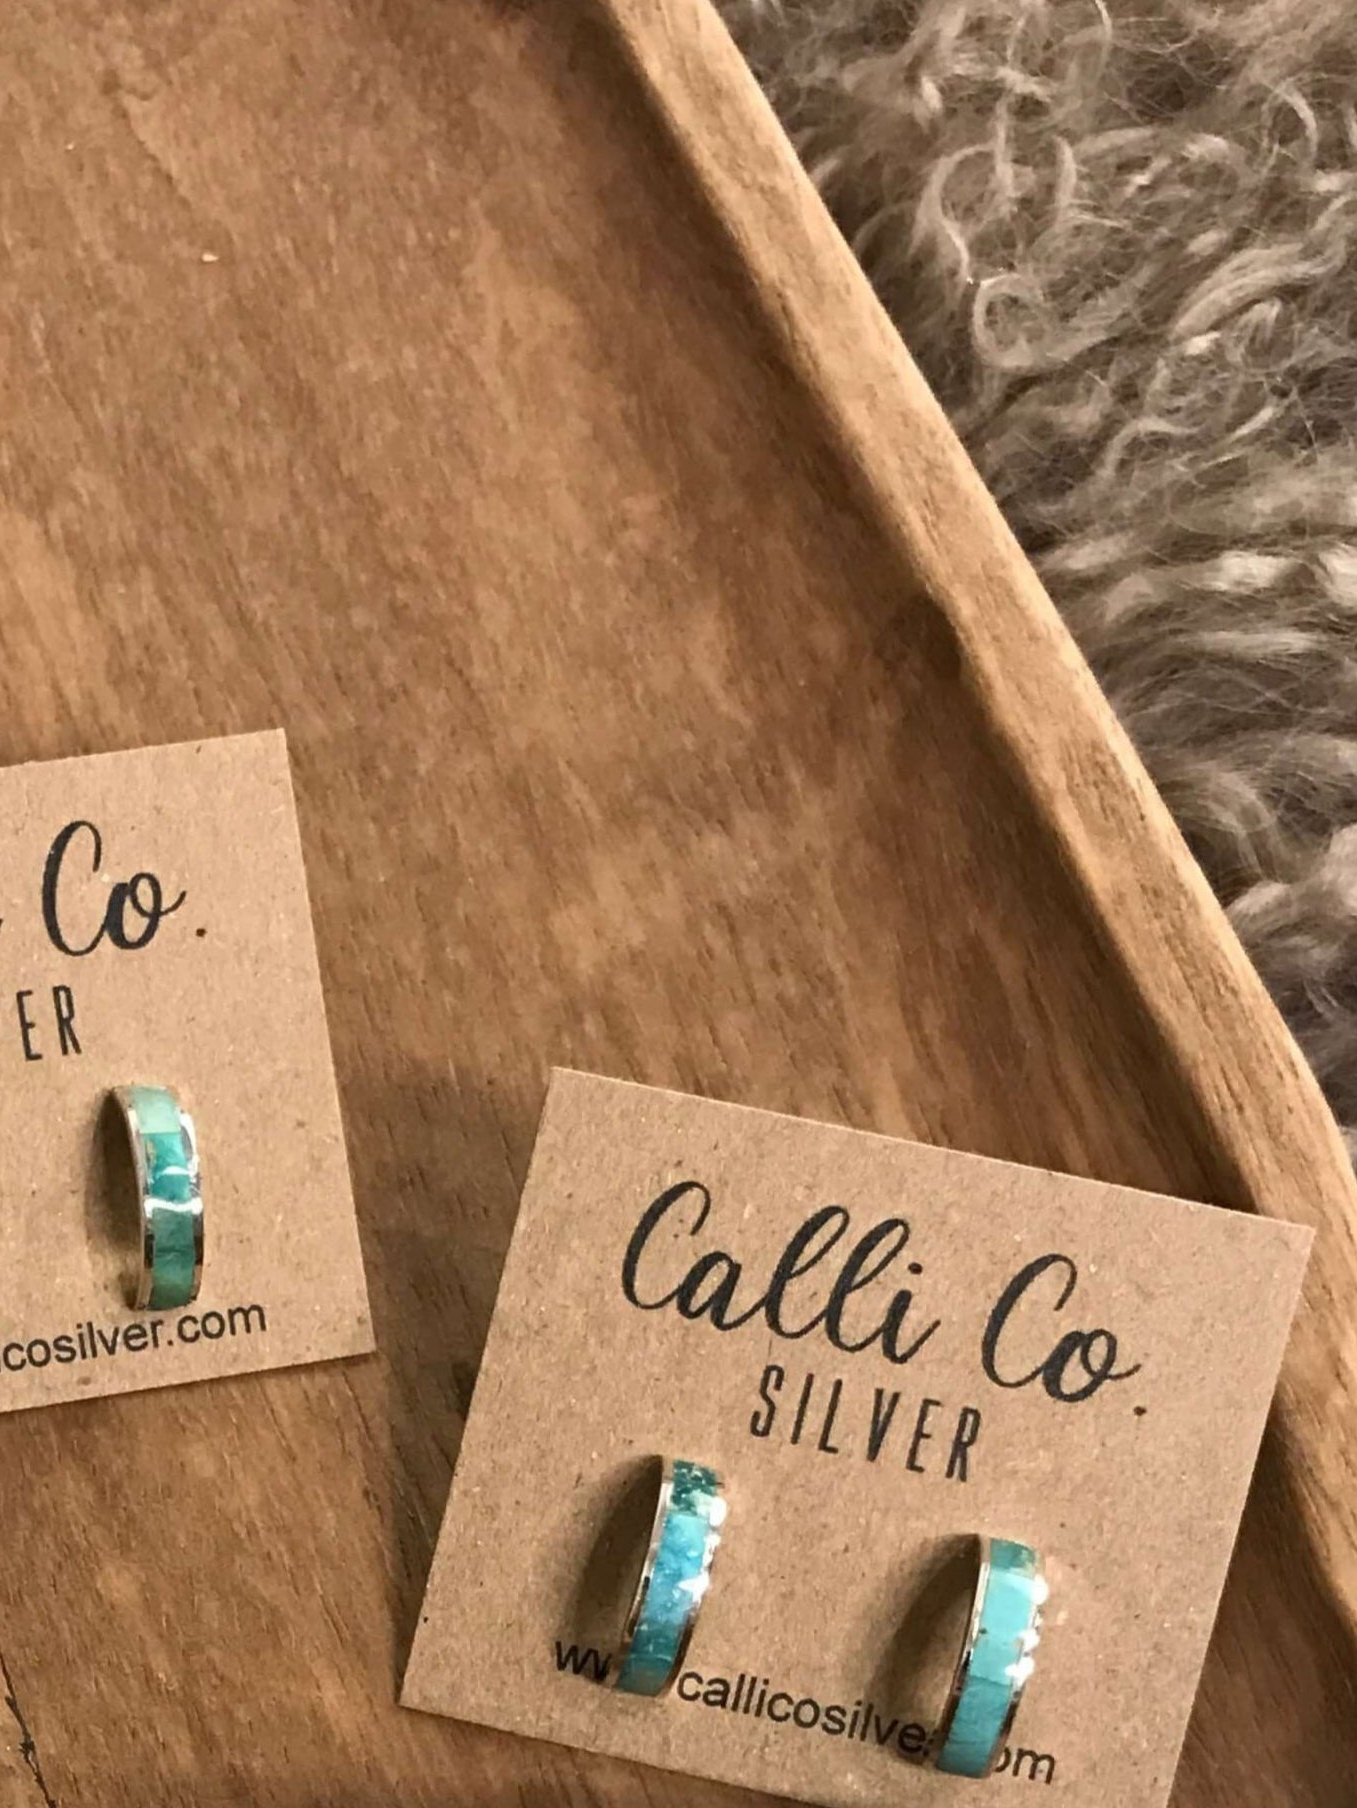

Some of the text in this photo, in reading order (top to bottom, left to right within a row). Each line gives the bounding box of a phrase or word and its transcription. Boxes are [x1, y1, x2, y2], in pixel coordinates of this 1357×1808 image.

[42, 820, 206, 956] Co.
[621, 1180, 1147, 1418] Calli Co.
[750, 1364, 982, 1482] SILVER
